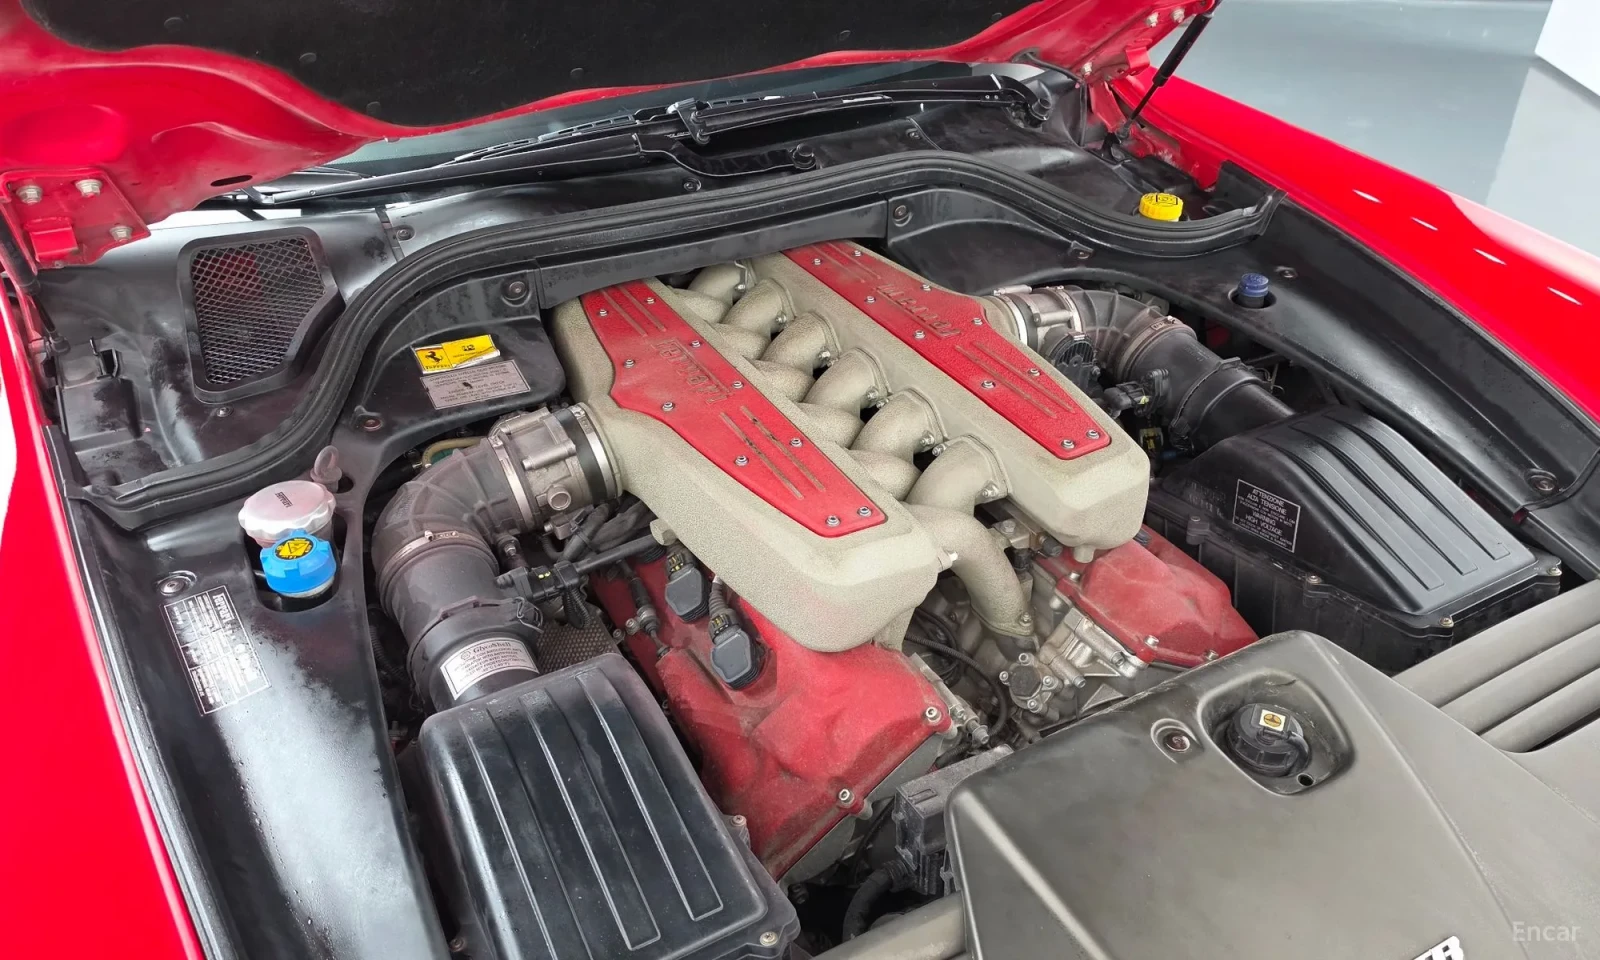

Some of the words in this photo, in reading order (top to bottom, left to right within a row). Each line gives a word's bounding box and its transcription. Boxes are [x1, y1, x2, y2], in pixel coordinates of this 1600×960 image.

[651, 339, 733, 405] Ferrari
[1261, 499, 1287, 515] TENSIONE
[212, 593, 235, 623] Ferrari
